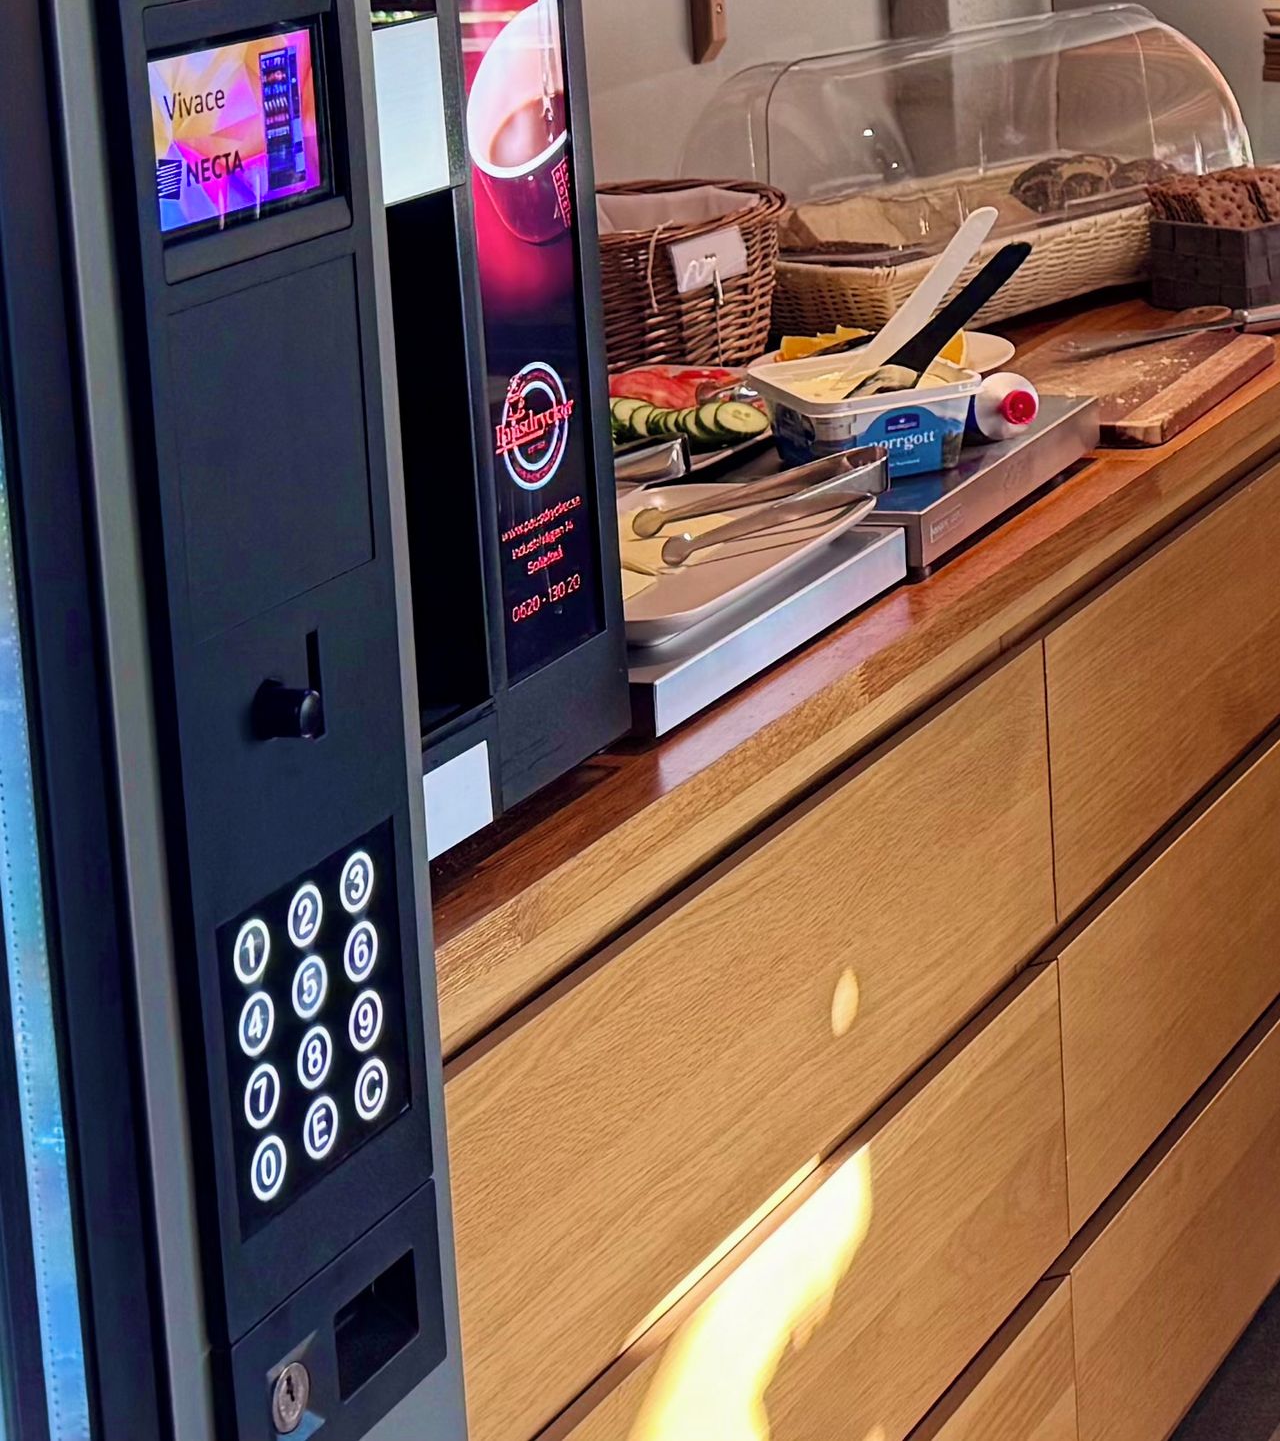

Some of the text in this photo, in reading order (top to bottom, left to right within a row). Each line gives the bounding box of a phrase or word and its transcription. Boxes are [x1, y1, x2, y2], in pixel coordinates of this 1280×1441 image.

[162, 88, 226, 122] Vivace
[186, 149, 245, 188] NECTA
[512, 594, 541, 623] 0620
[548, 581, 566, 603] 130
[566, 573, 581, 594] 20
[243, 863, 364, 968] 1 2 3
[248, 934, 368, 1040] 4 5 6
[253, 1003, 371, 1114] 7 8 9
[261, 1069, 381, 1187] 0 E C
